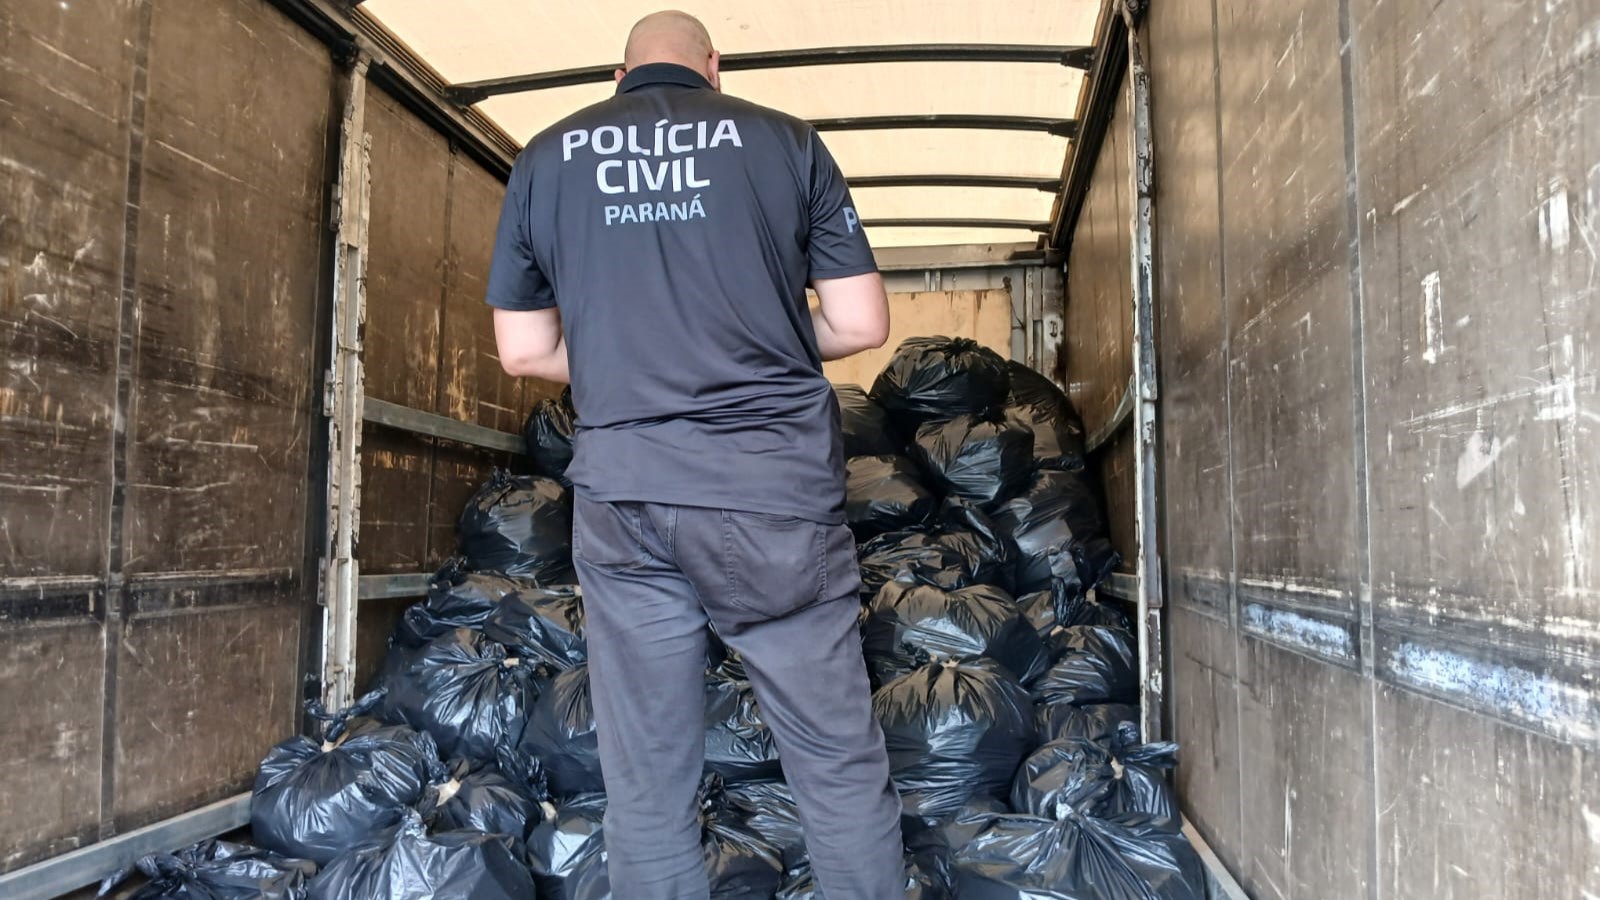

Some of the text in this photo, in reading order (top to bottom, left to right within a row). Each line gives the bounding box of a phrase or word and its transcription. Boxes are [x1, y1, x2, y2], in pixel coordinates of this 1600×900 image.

[562, 118, 743, 162] POLÍCIA
[596, 156, 711, 194] CIVIL
[604, 193, 707, 226] PARANÁ
